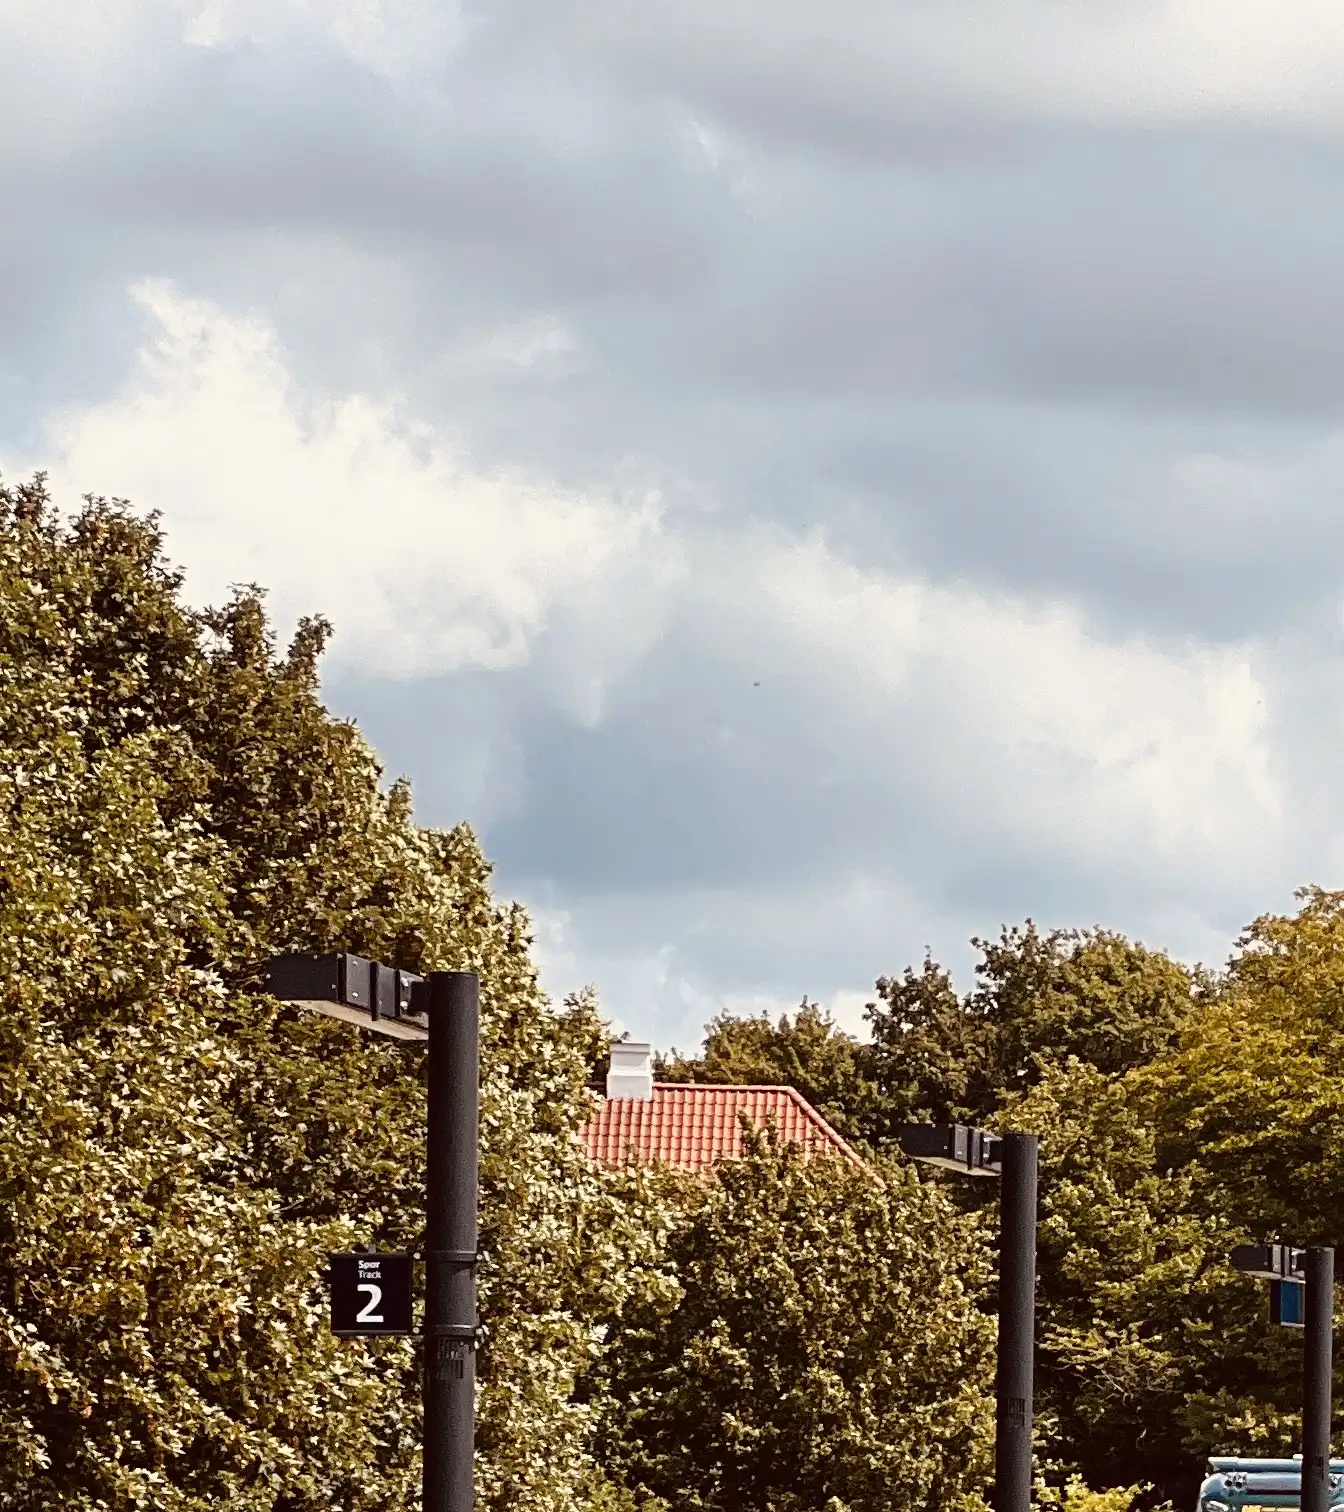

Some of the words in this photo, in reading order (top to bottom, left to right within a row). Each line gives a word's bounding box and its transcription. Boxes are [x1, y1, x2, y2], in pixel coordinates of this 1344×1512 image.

[358, 1260, 380, 1269] Spor
[358, 1270, 381, 1279] Track
[356, 1284, 384, 1322] 2
